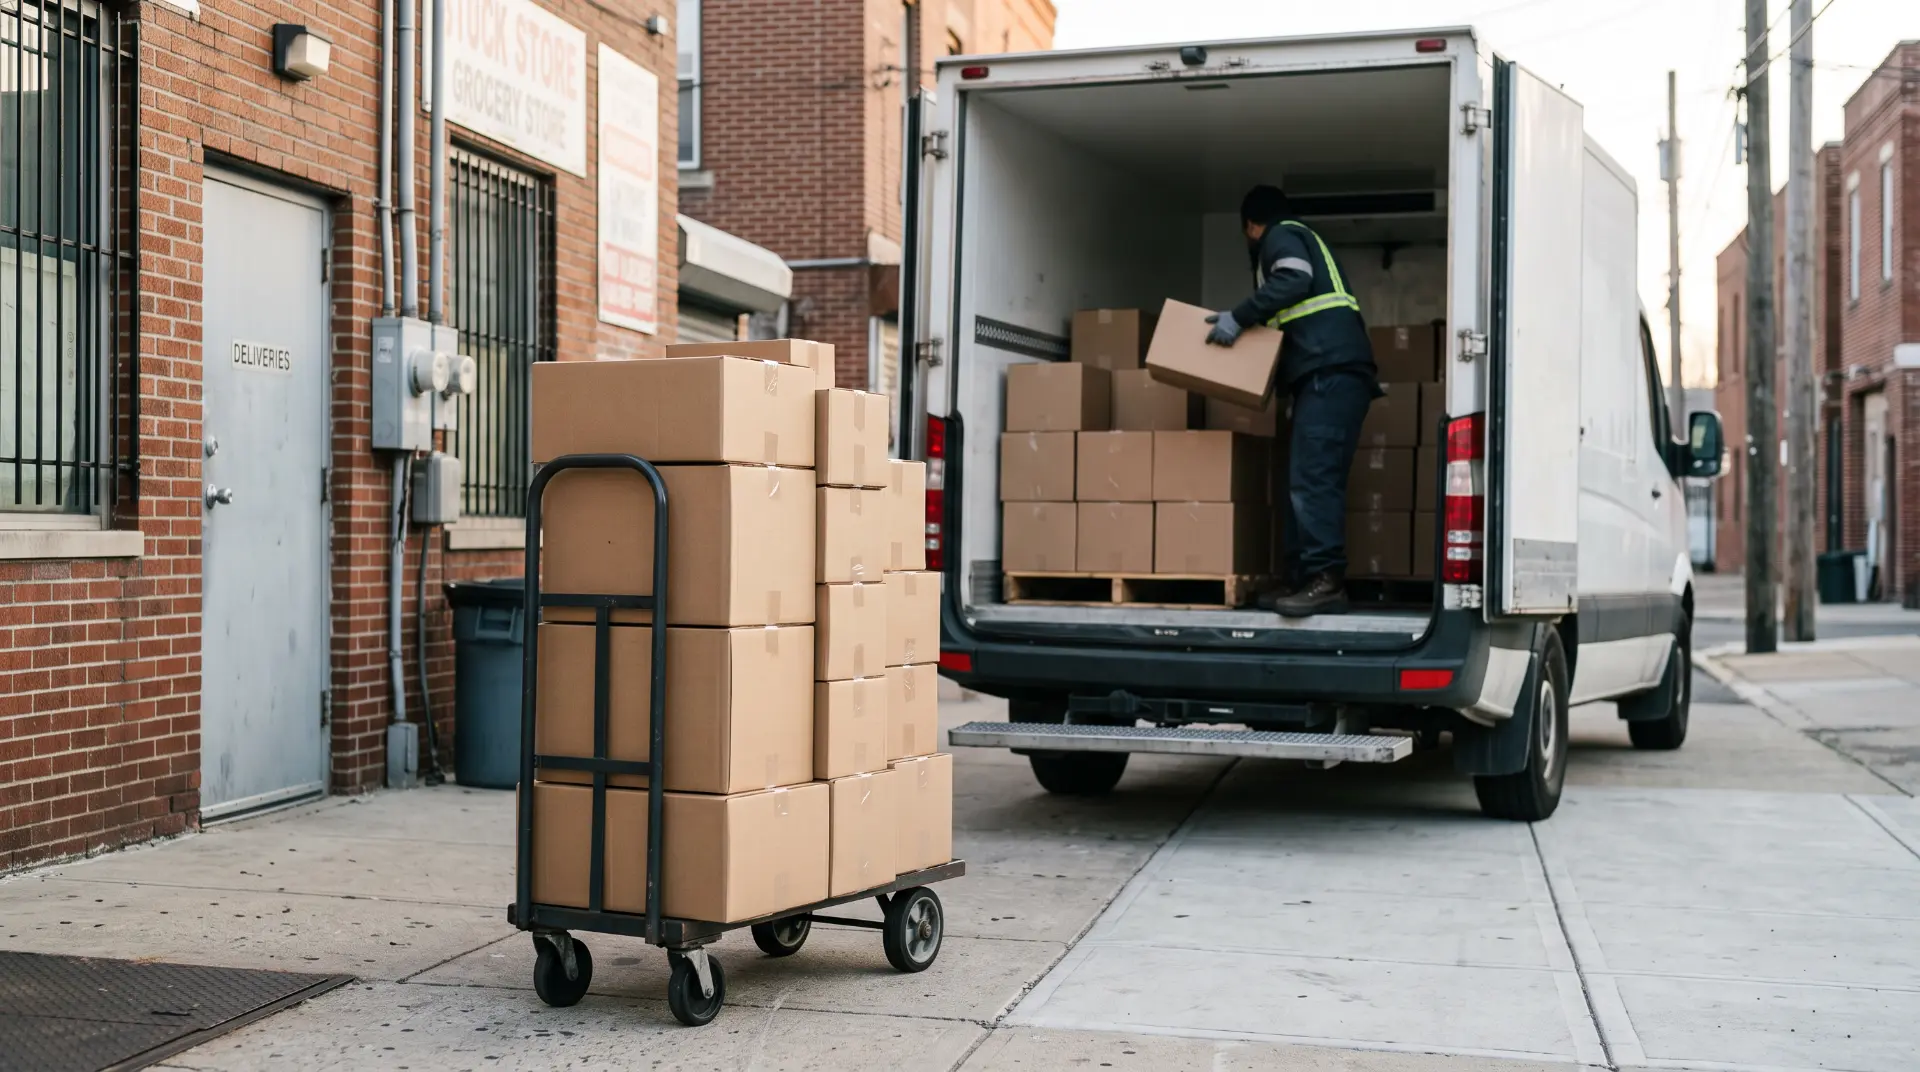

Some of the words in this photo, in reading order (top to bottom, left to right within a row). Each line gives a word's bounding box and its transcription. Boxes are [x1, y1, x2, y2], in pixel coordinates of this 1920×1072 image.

[515, 11, 577, 101] STORE
[452, 59, 523, 130] GROCERY
[234, 343, 290, 371] DELIVERIES
